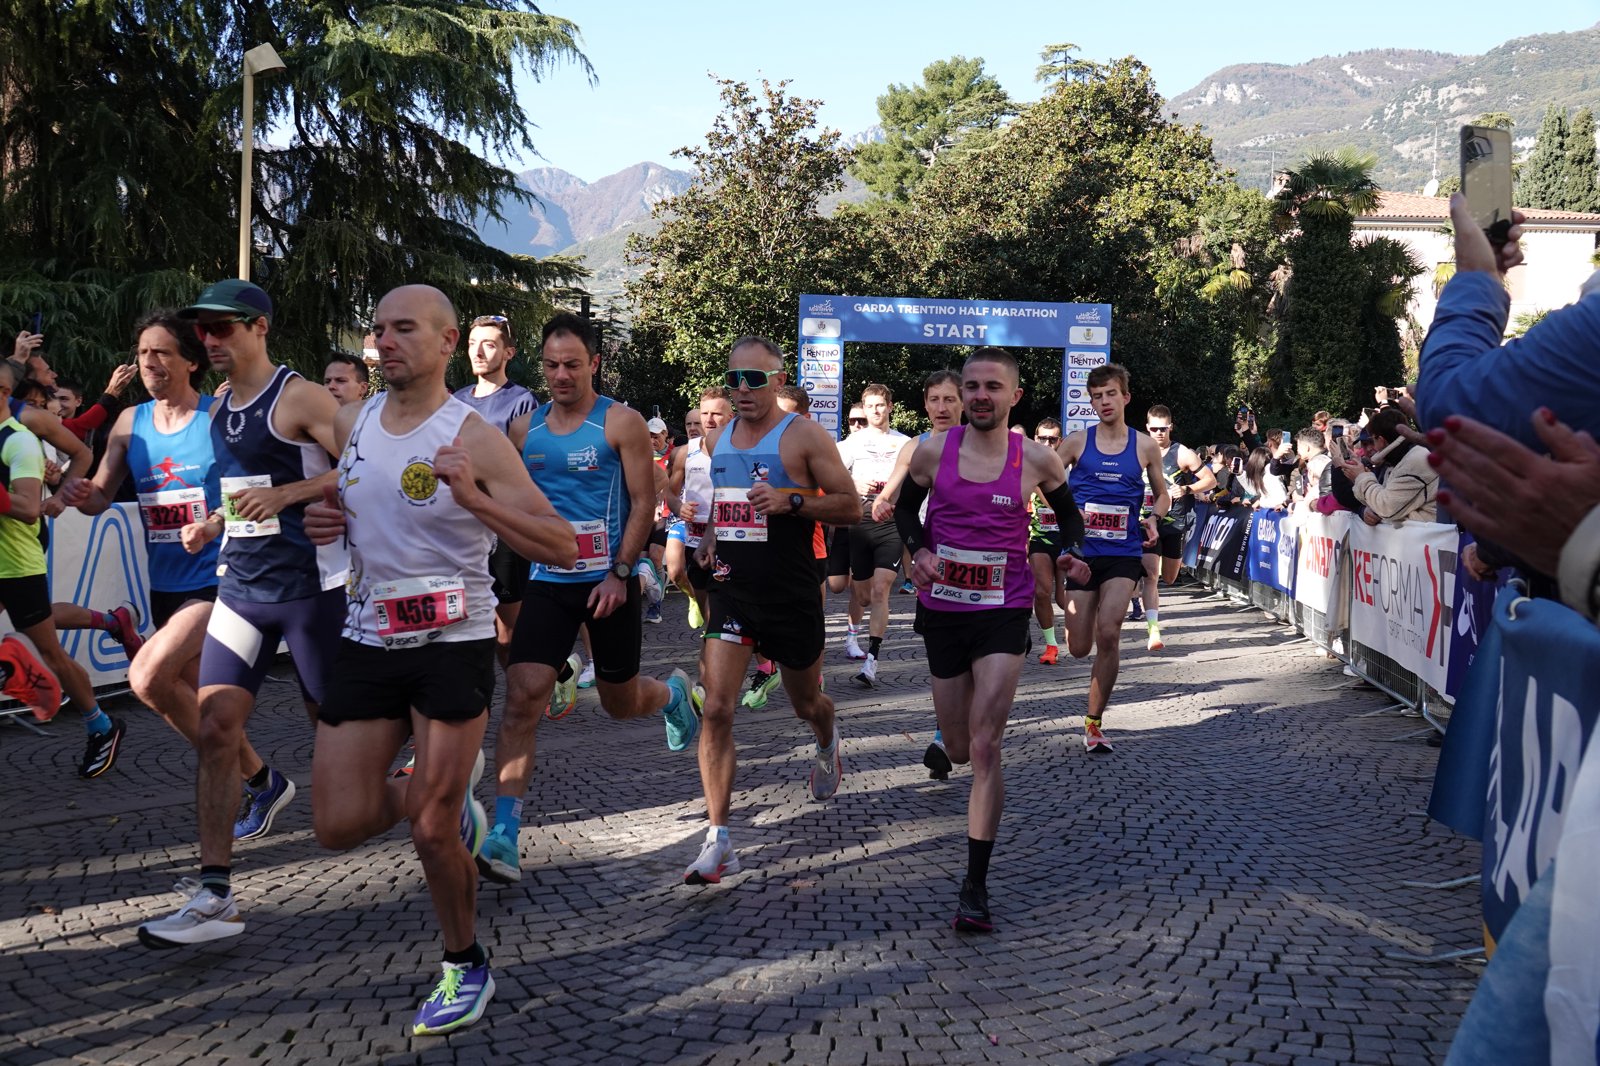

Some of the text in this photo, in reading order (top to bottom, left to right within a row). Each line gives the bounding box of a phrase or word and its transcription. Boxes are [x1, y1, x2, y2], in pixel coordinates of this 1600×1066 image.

[853, 303, 1058, 318] GARDA TRENTINO HALF MARATHON
[923, 323, 988, 339] START
[803, 363, 838, 372] GARDA
[1070, 355, 1106, 367] TRENTINO
[1070, 370, 1089, 379] GAR
[812, 400, 837, 409] asics
[1080, 407, 1098, 416] asic
[151, 504, 188, 526] 3227
[718, 503, 751, 523] 1663
[1091, 513, 1121, 528] 2558
[948, 561, 988, 586] 2219
[942, 588, 963, 599] asics
[1353, 548, 1425, 632] KEFORMA
[396, 596, 437, 625] 456
